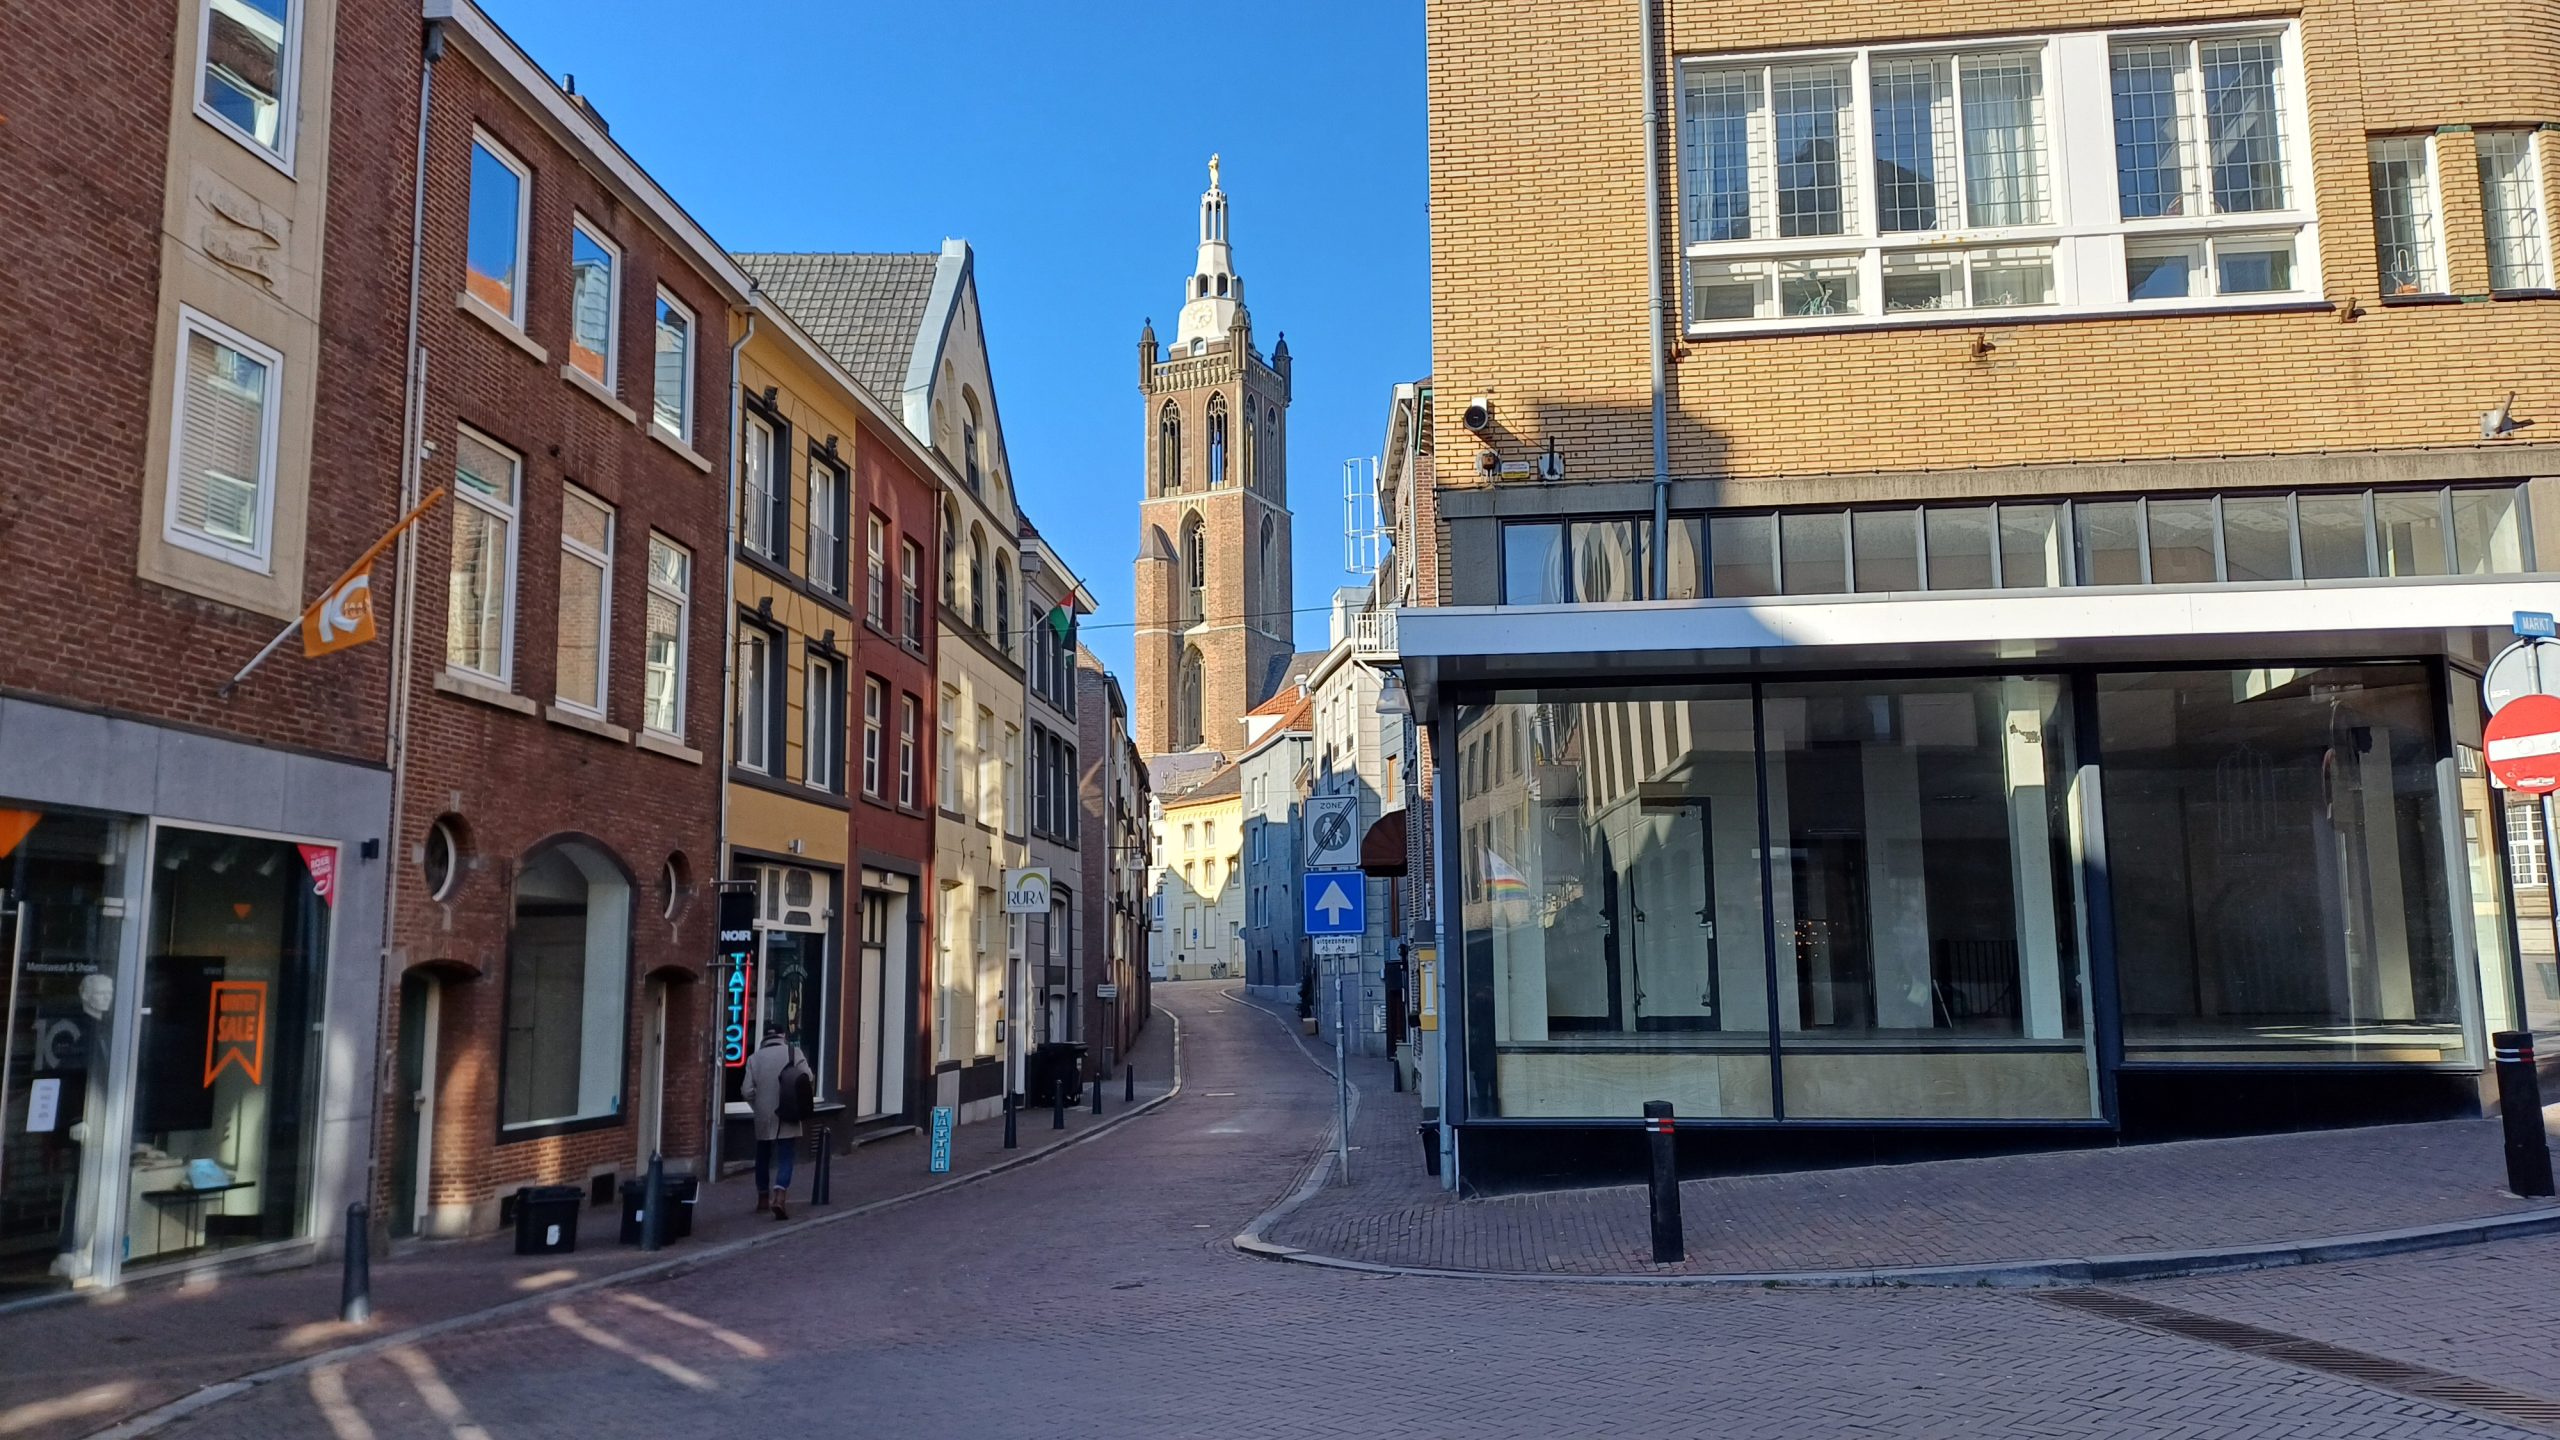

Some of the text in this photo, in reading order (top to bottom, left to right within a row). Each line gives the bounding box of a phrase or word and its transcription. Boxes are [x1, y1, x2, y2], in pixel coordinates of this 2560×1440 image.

[2522, 616, 2550, 632] MARKT
[1008, 890, 1044, 905] RURA
[721, 930, 752, 942] NOIR
[725, 952, 746, 1061] TATTOO
[217, 1015, 256, 1041] SALE
[935, 1107, 950, 1170] TATTOO
